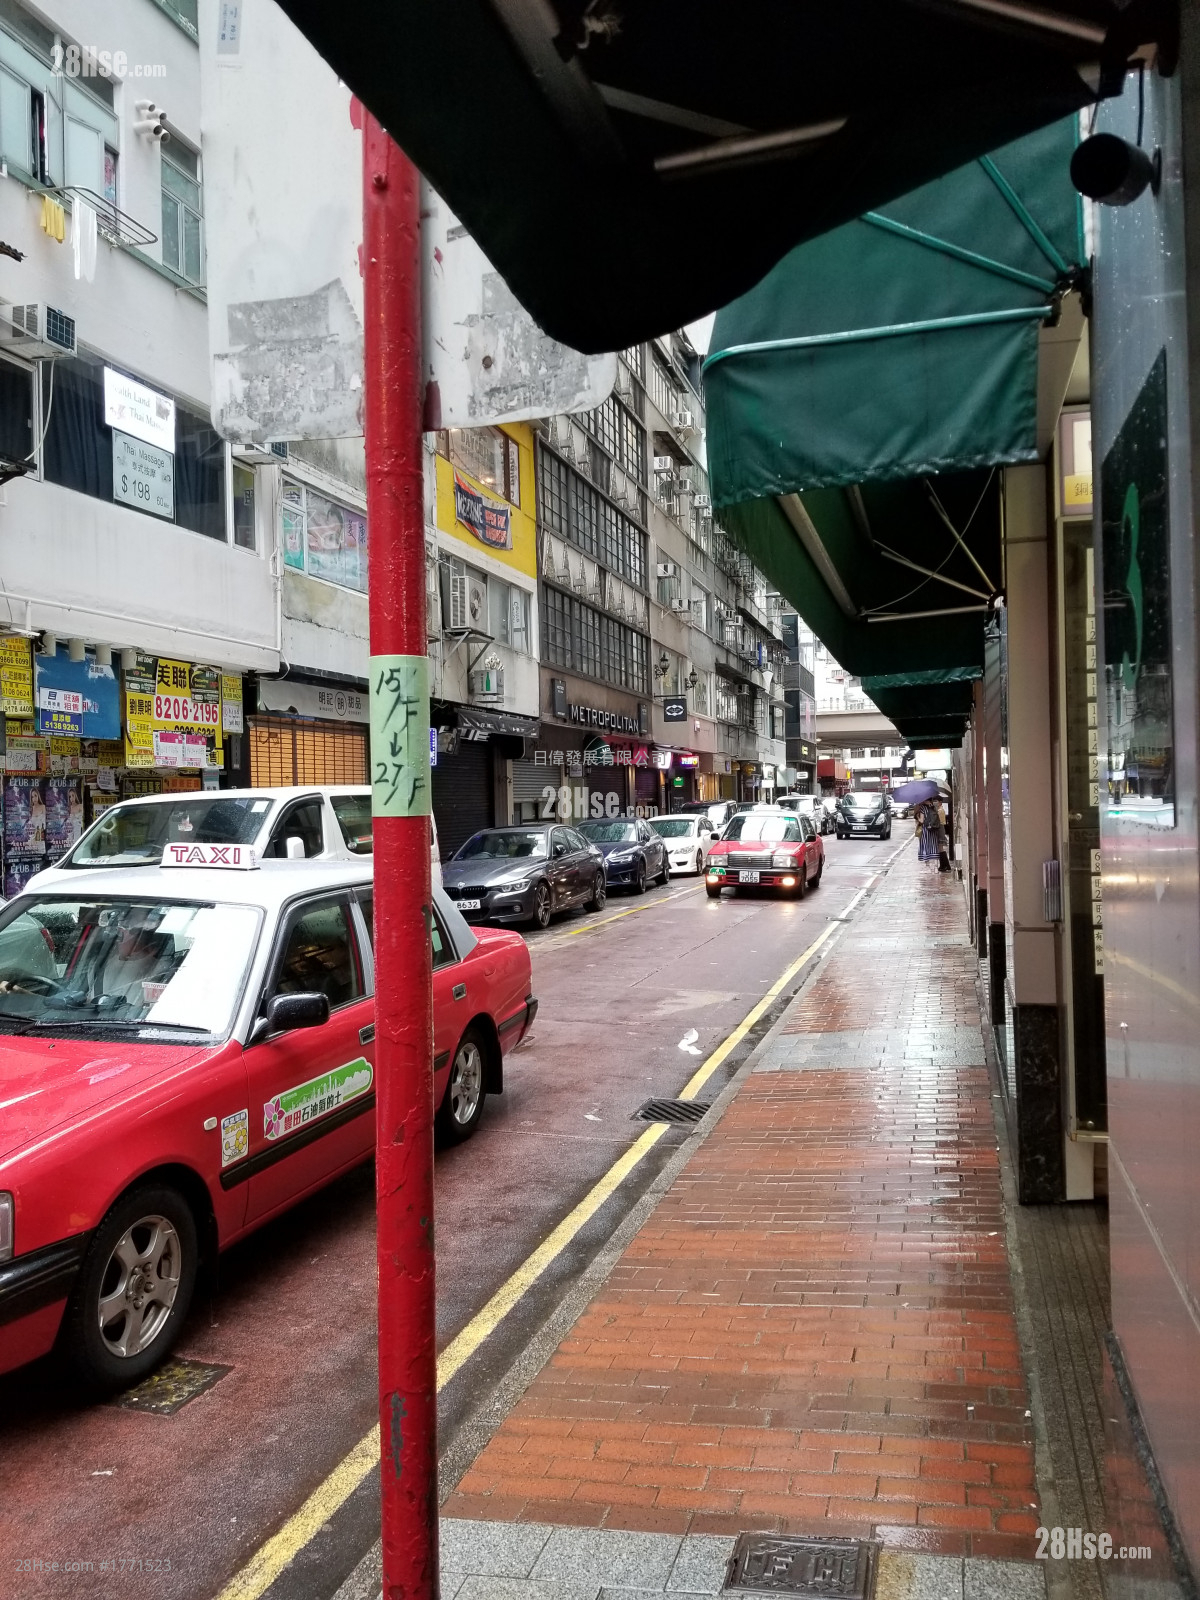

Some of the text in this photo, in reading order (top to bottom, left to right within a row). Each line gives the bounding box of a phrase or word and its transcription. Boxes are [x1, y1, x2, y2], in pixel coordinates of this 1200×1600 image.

[123, 441, 165, 469] Thai Massage
[121, 474, 151, 501] $ 198
[1074, 482, 1094, 497] 銅
[156, 495, 164, 507] 60
[158, 664, 193, 690] 美聯
[129, 698, 152, 716] 劉景明
[45, 721, 79, 731] 5138 9263
[571, 703, 639, 732] METROPOLITAN
[9, 778, 29, 787] CLUB
[49, 779, 67, 788] CLUB
[374, 762, 426, 810] 27/F
[170, 845, 241, 865] TAXI
[11, 864, 30, 874] CLUB
[456, 901, 478, 909] 8632
[283, 1090, 342, 1132] 豐田石油氣的士
